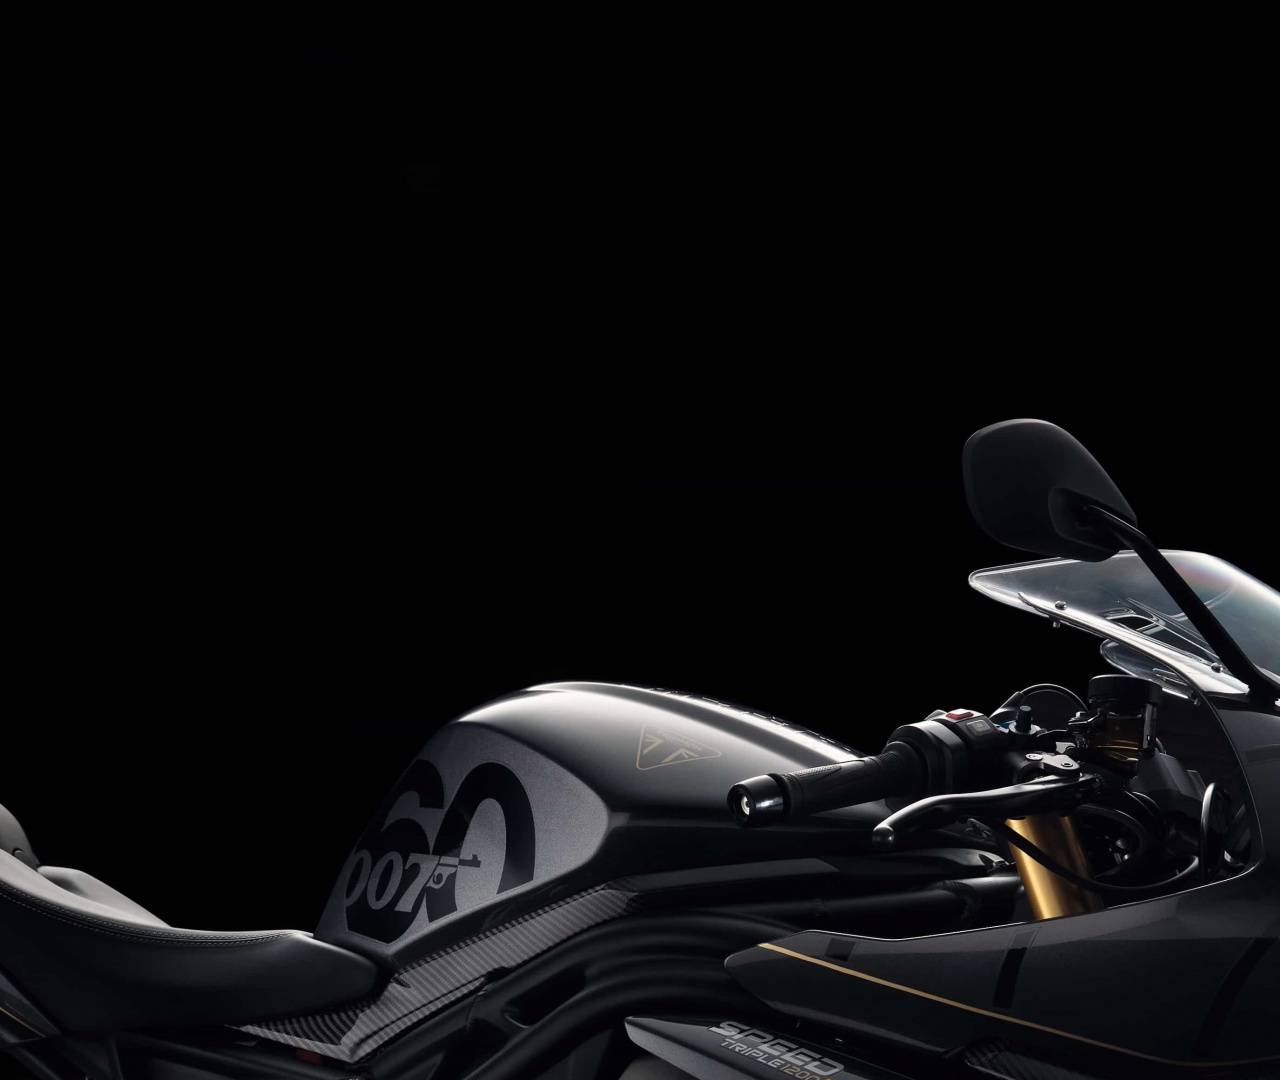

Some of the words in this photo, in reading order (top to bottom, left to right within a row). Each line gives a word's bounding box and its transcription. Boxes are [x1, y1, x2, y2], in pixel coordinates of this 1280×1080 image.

[342, 849, 441, 912] 007
[708, 1021, 845, 1076] SPEED
[720, 1038, 786, 1068] TRIPLE
